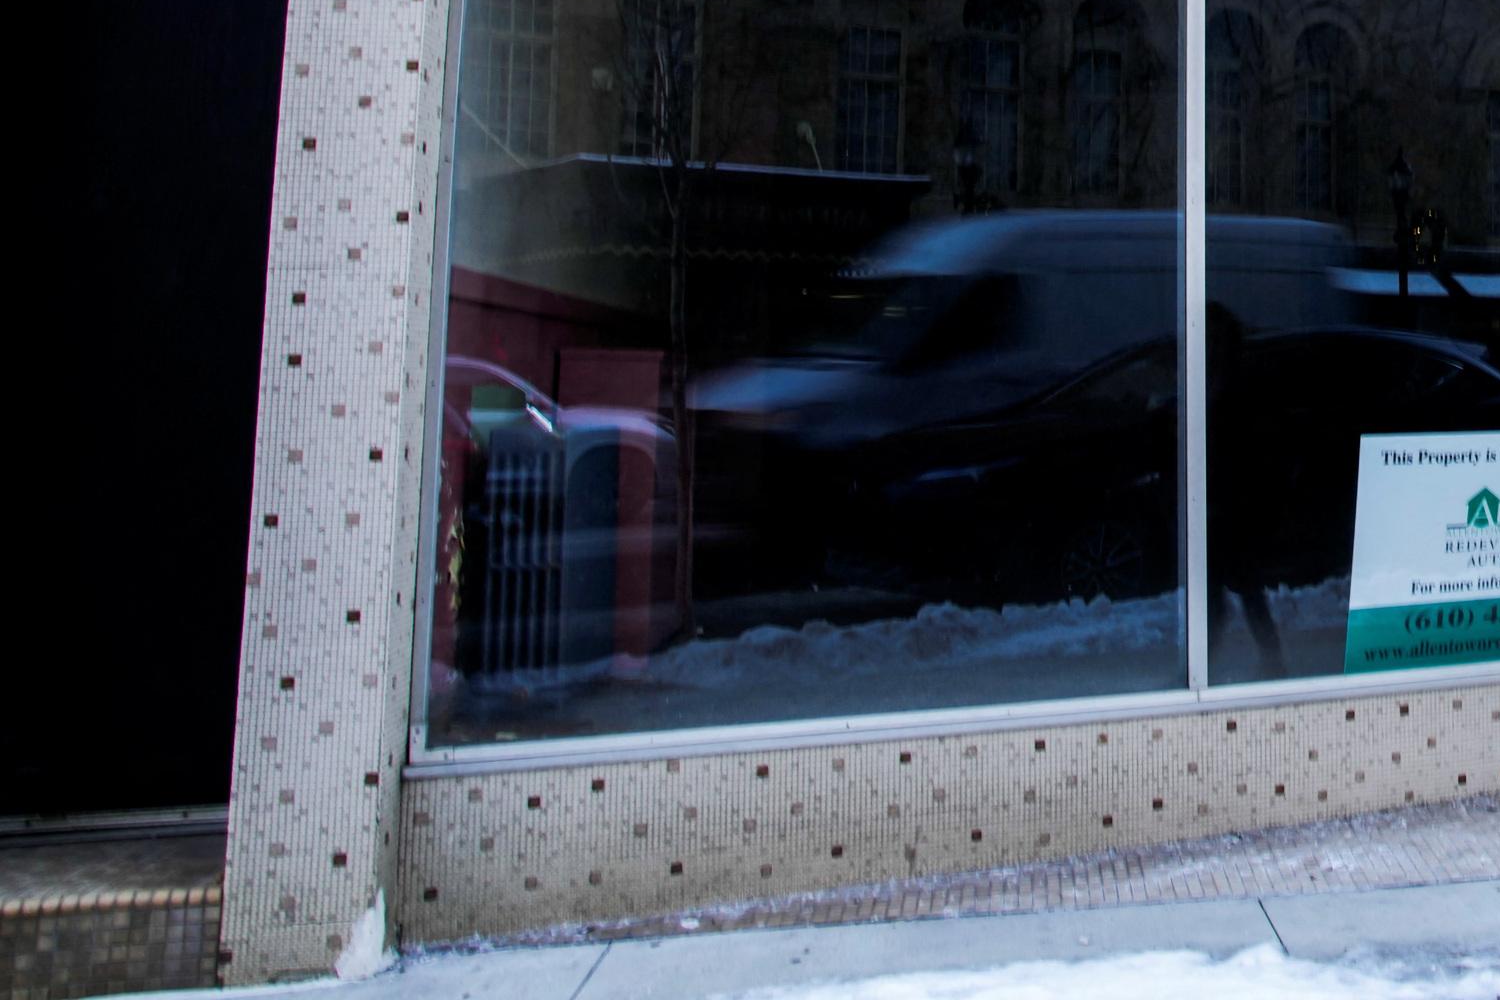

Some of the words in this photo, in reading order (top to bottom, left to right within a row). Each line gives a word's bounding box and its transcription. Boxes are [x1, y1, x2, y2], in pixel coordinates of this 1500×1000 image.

[1382, 450, 1413, 466] This
[1418, 450, 1480, 467] Property
[1486, 448, 1497, 464] is
[1411, 581, 1435, 595] For
[1439, 580, 1473, 592] more
[1404, 607, 1474, 633] (610)
